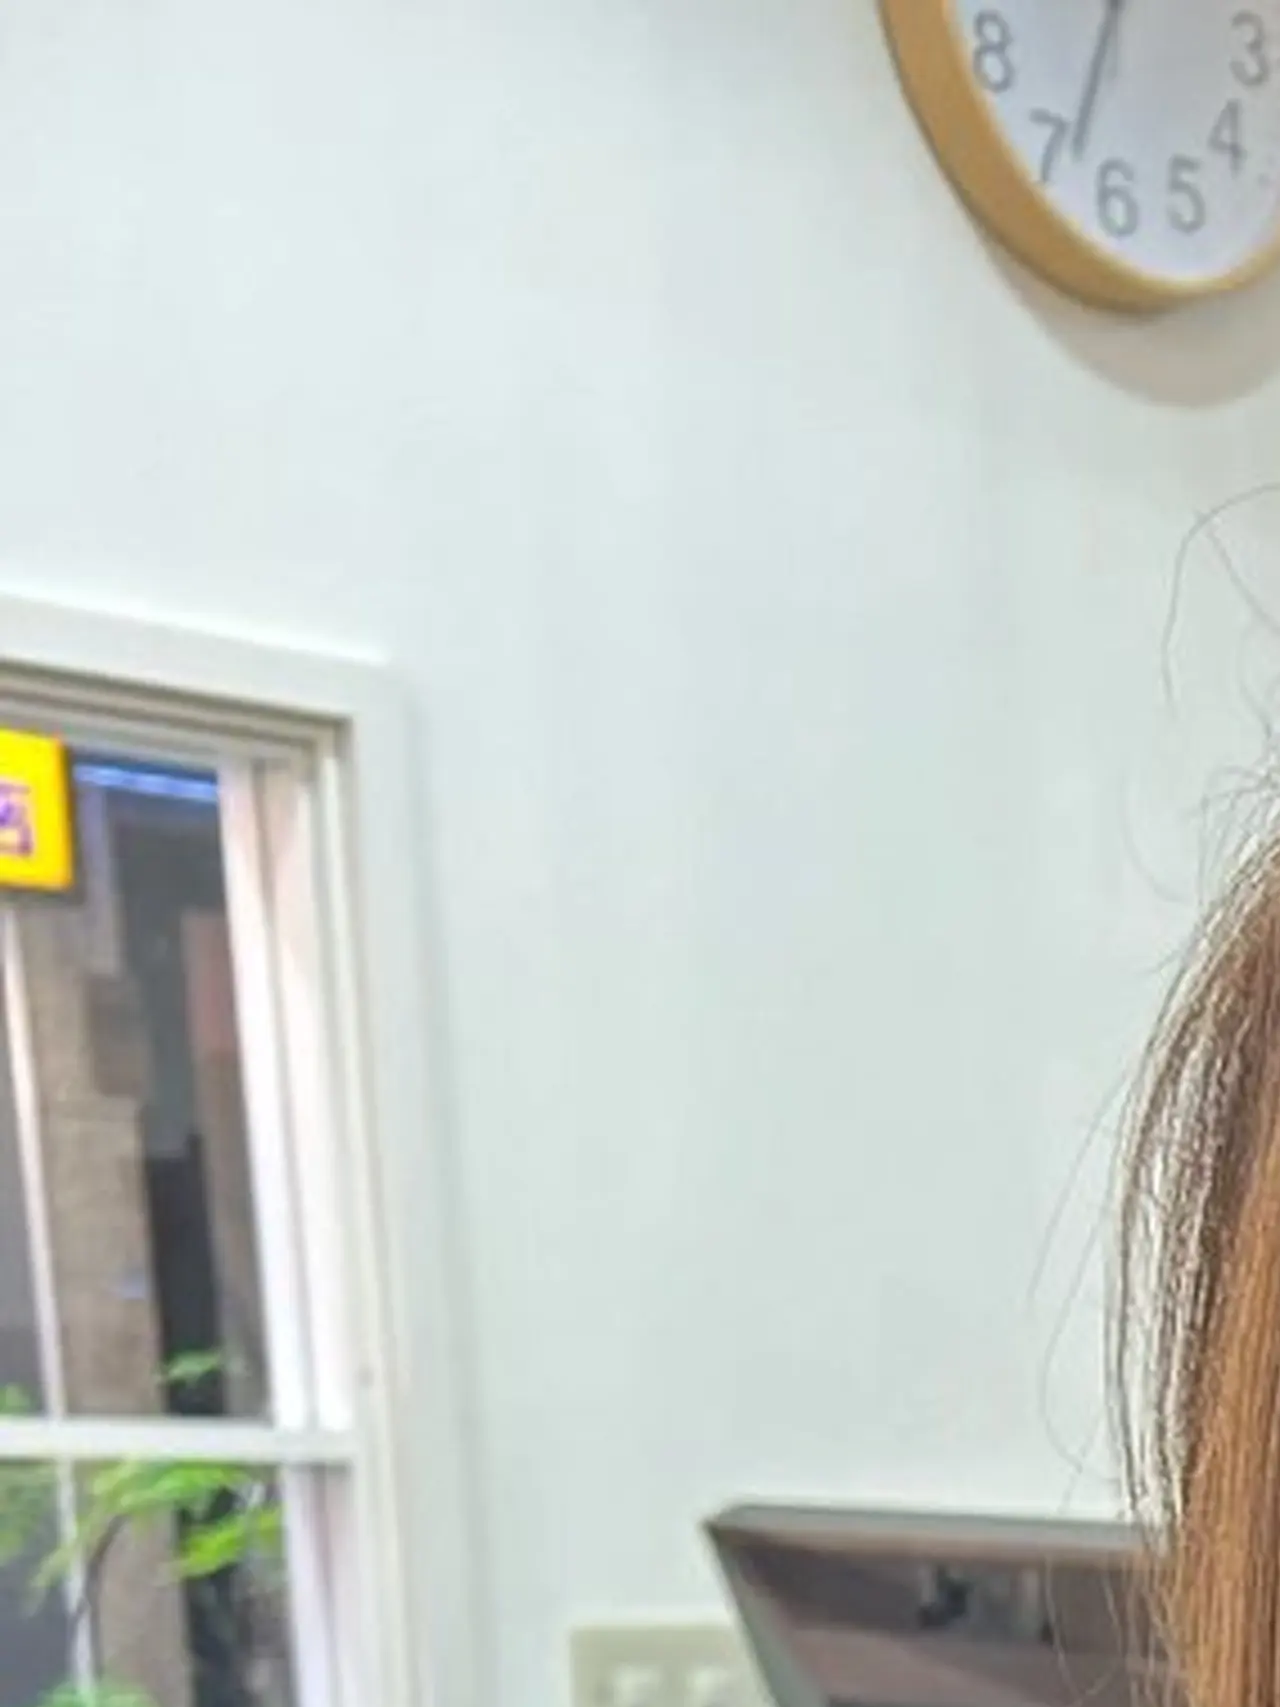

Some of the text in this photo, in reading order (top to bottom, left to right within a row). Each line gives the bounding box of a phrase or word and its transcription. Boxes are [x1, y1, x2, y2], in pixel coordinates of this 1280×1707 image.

[973, 10, 1015, 93] 8
[1229, 9, 1269, 86] 3
[1028, 107, 1070, 186] 7
[1206, 98, 1247, 174] 4
[1097, 158, 1138, 237] 6
[1165, 152, 1206, 234] 5
